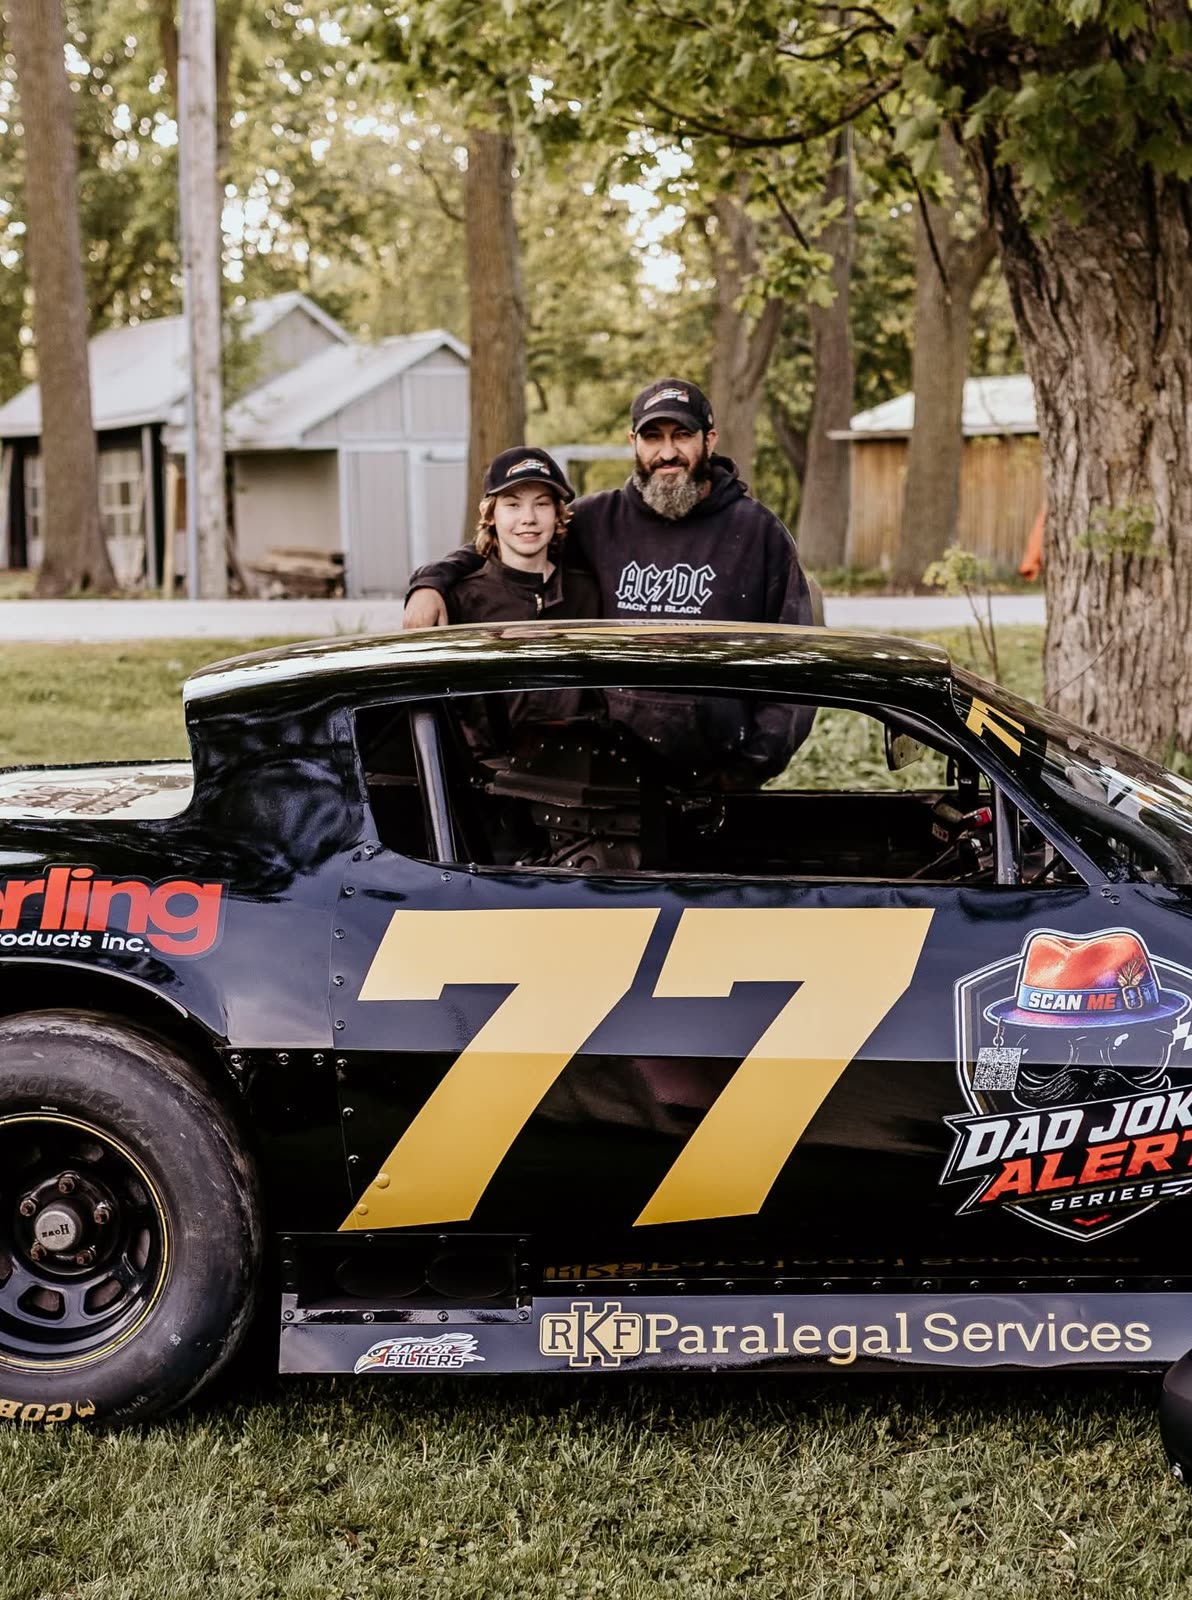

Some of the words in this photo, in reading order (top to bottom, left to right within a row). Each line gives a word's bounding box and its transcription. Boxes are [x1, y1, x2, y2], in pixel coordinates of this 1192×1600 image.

[615, 560, 716, 606] AC/DC
[617, 601, 647, 613] BACK
[650, 604, 662, 613] IN
[664, 605, 702, 614] BLACK
[0, 867, 222, 956] rling
[0, 930, 92, 948] oducts
[101, 932, 150, 952] inc.
[1028, 992, 1083, 1010] SCAN
[1085, 993, 1117, 1010] ME
[337, 908, 935, 1231] 77
[956, 1109, 1084, 1172] DAD
[1050, 1185, 1155, 1211] SERIES
[539, 1302, 643, 1367] RKF
[645, 1312, 914, 1366] Paralegal
[922, 1312, 1153, 1353] Services
[384, 1353, 464, 1367] FILTERS
[388, 1344, 453, 1354] RAPTOR
